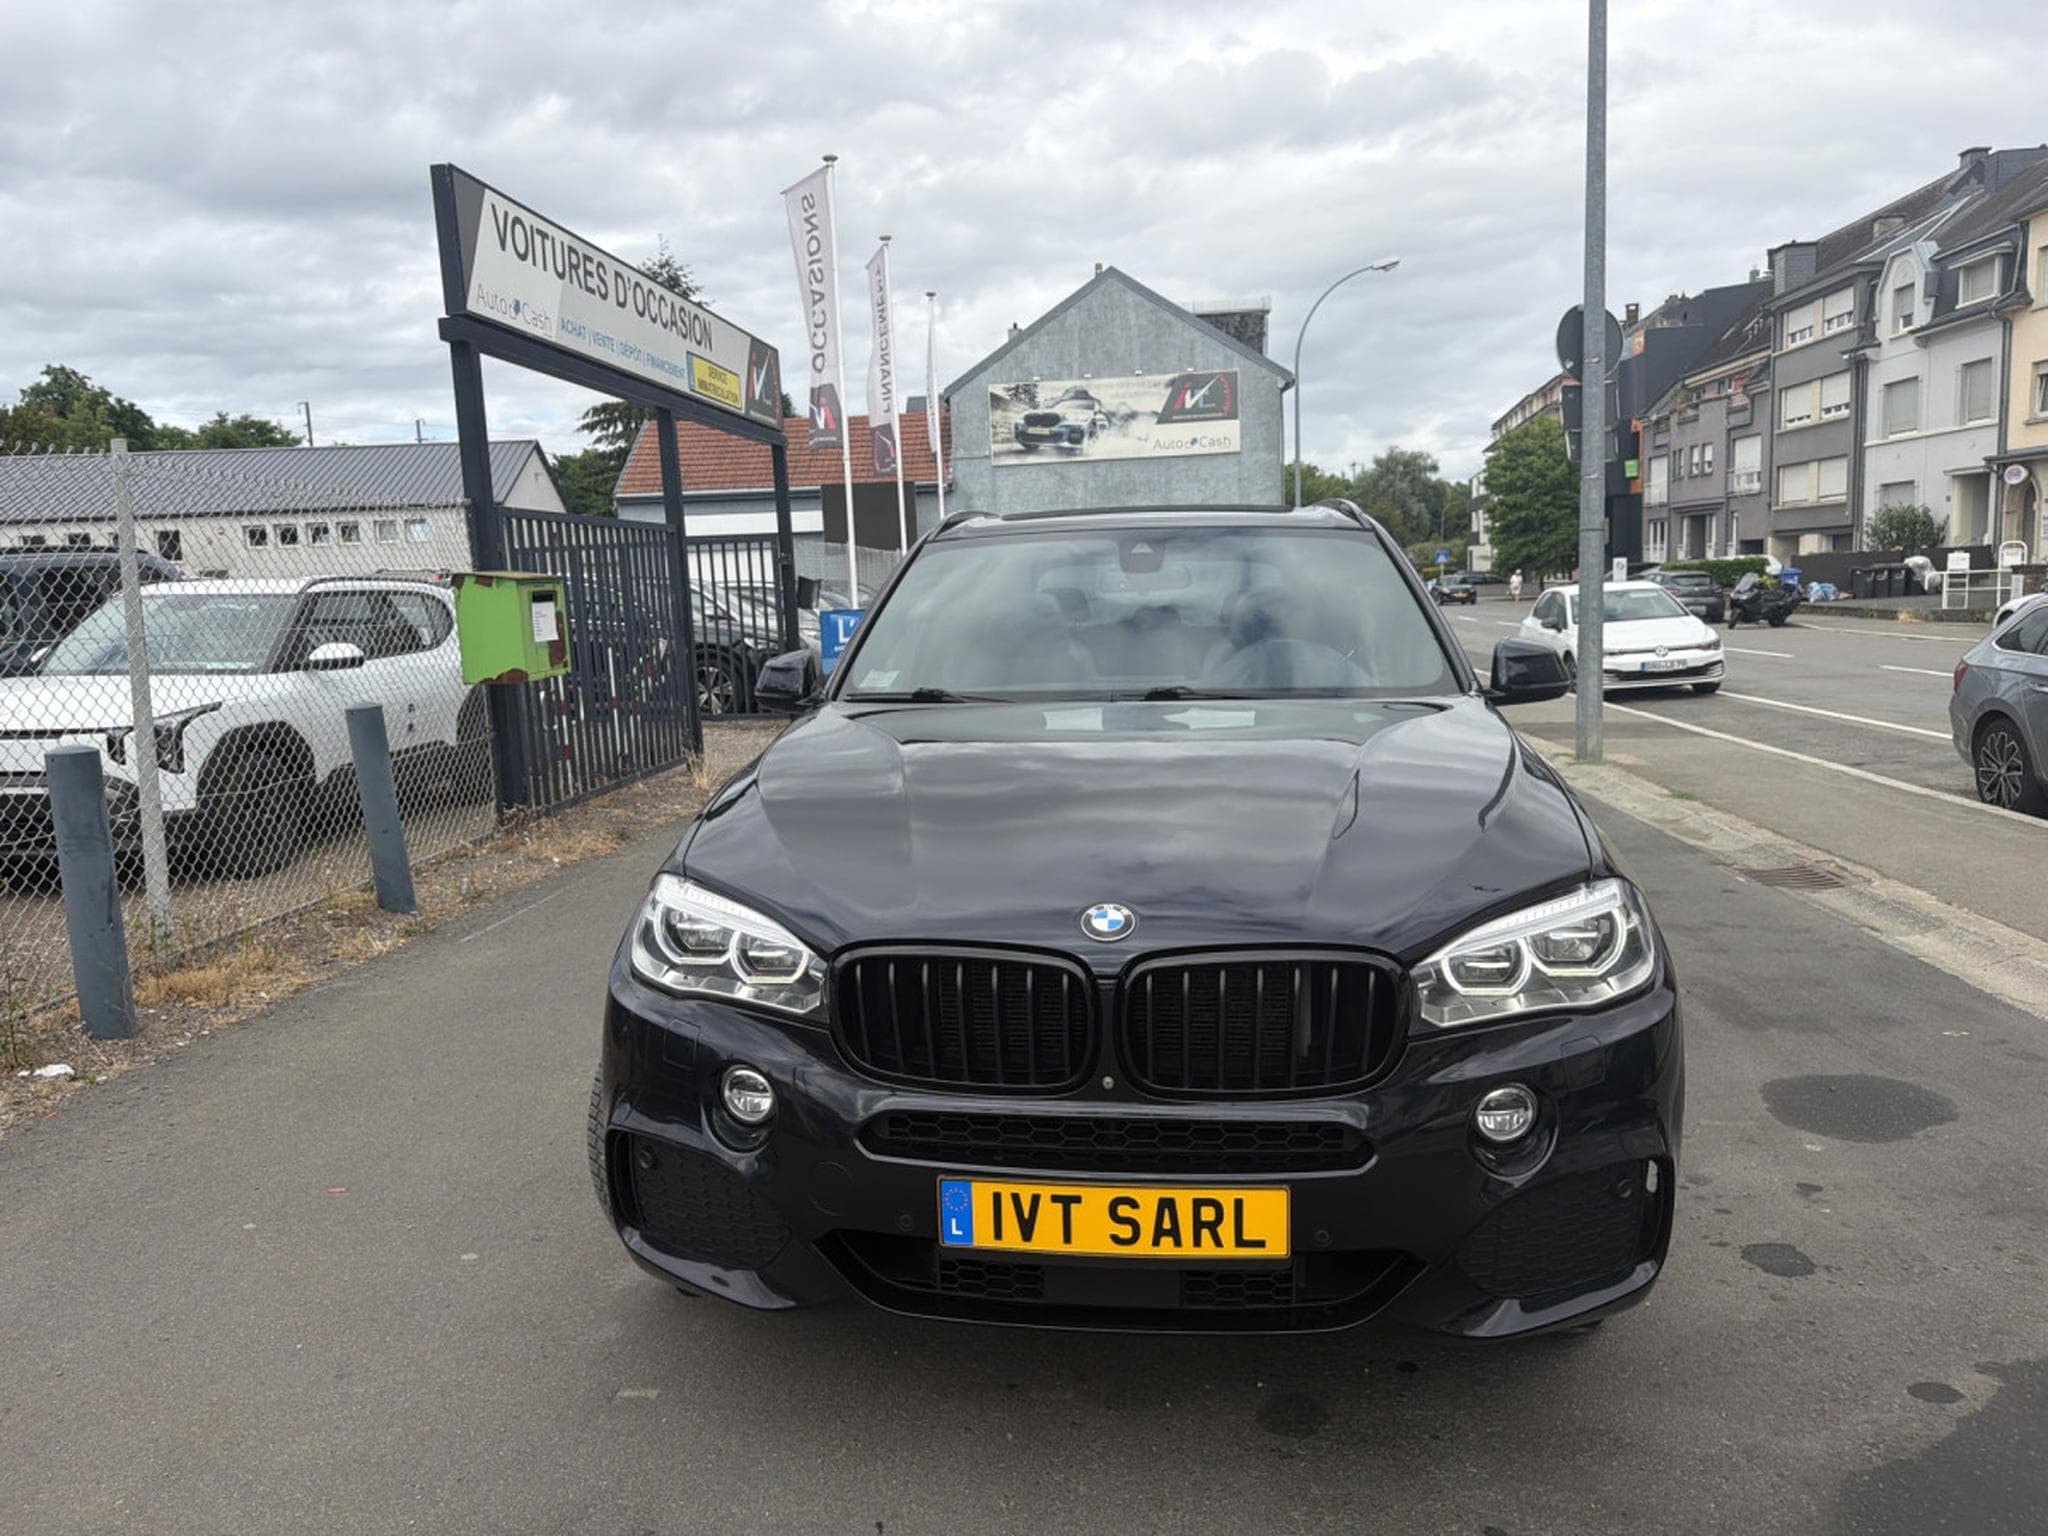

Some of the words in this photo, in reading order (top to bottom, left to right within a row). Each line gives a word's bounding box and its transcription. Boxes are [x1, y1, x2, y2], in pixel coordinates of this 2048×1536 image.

[490, 202, 608, 302] VOITURES
[614, 269, 714, 352] D'OCCASION
[1153, 438, 1184, 450] Auto
[1200, 436, 1232, 449] Cash
[951, 1217, 963, 1236] L
[992, 1191, 1083, 1244] IVT
[1108, 1195, 1267, 1249] SARL
